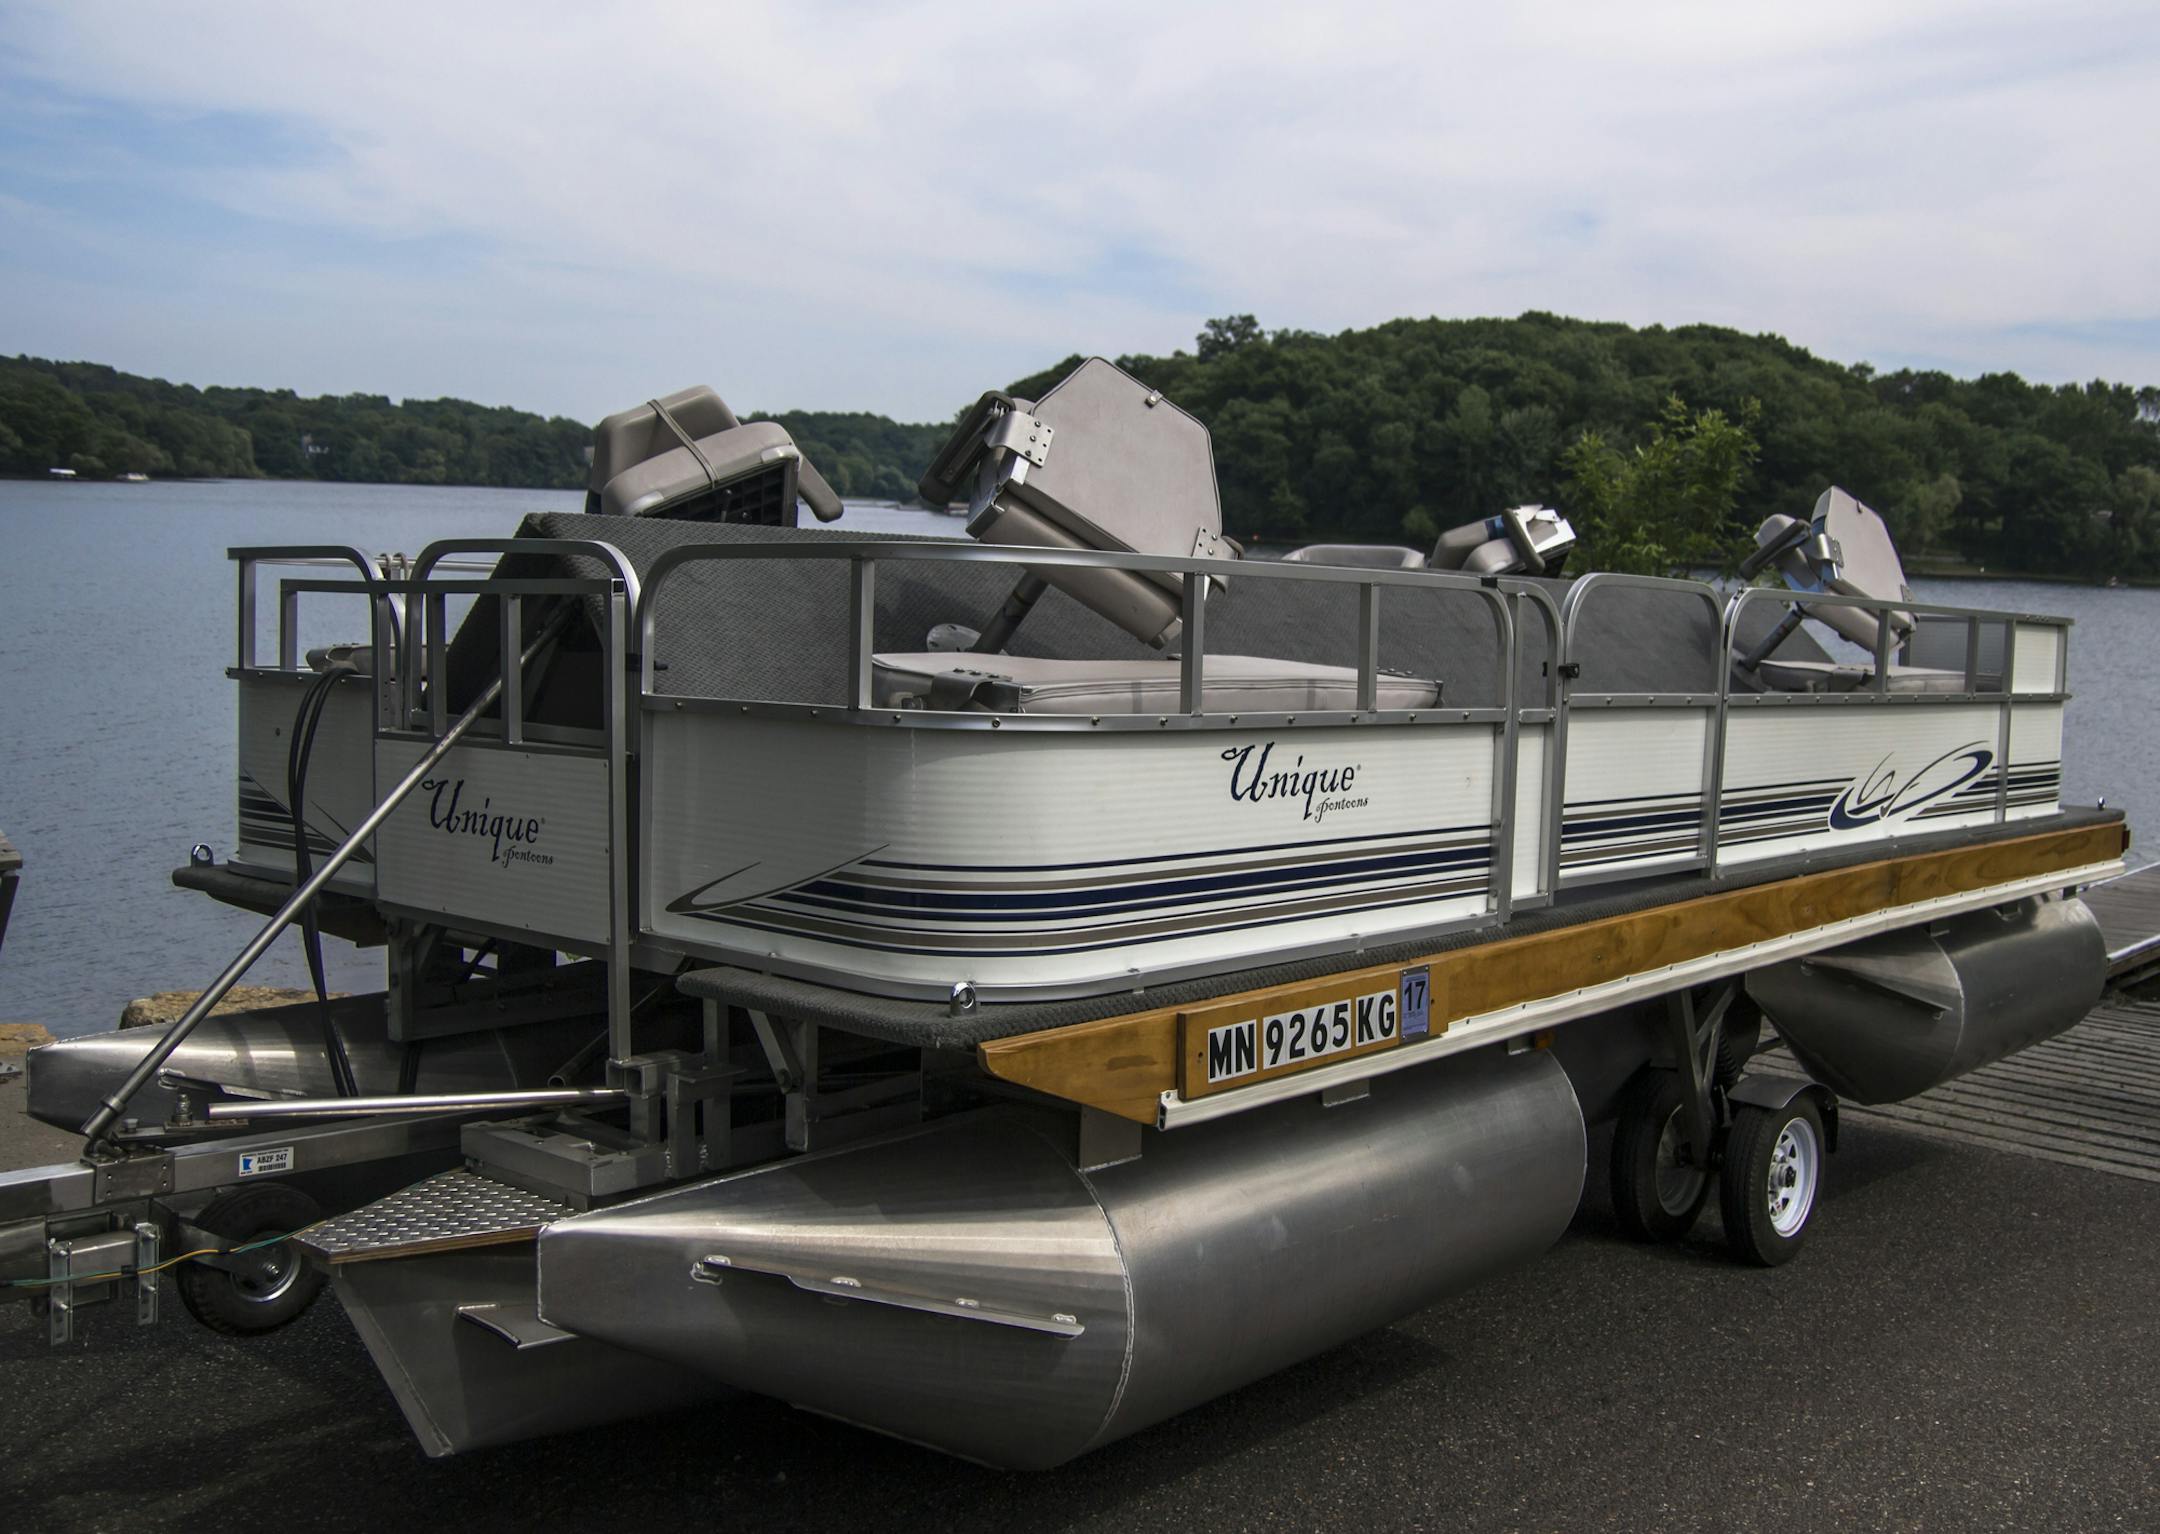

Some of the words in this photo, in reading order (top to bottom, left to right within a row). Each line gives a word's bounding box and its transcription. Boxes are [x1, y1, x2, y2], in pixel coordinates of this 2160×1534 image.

[422, 779, 539, 862] Unique
[1221, 741, 1355, 821] Unique
[1404, 980, 1426, 1011] 17
[1209, 1023, 1255, 1080] MN
[1265, 1003, 1349, 1066] 9265
[1357, 994, 1395, 1044] KG
[276, 1154, 288, 1162] 247
